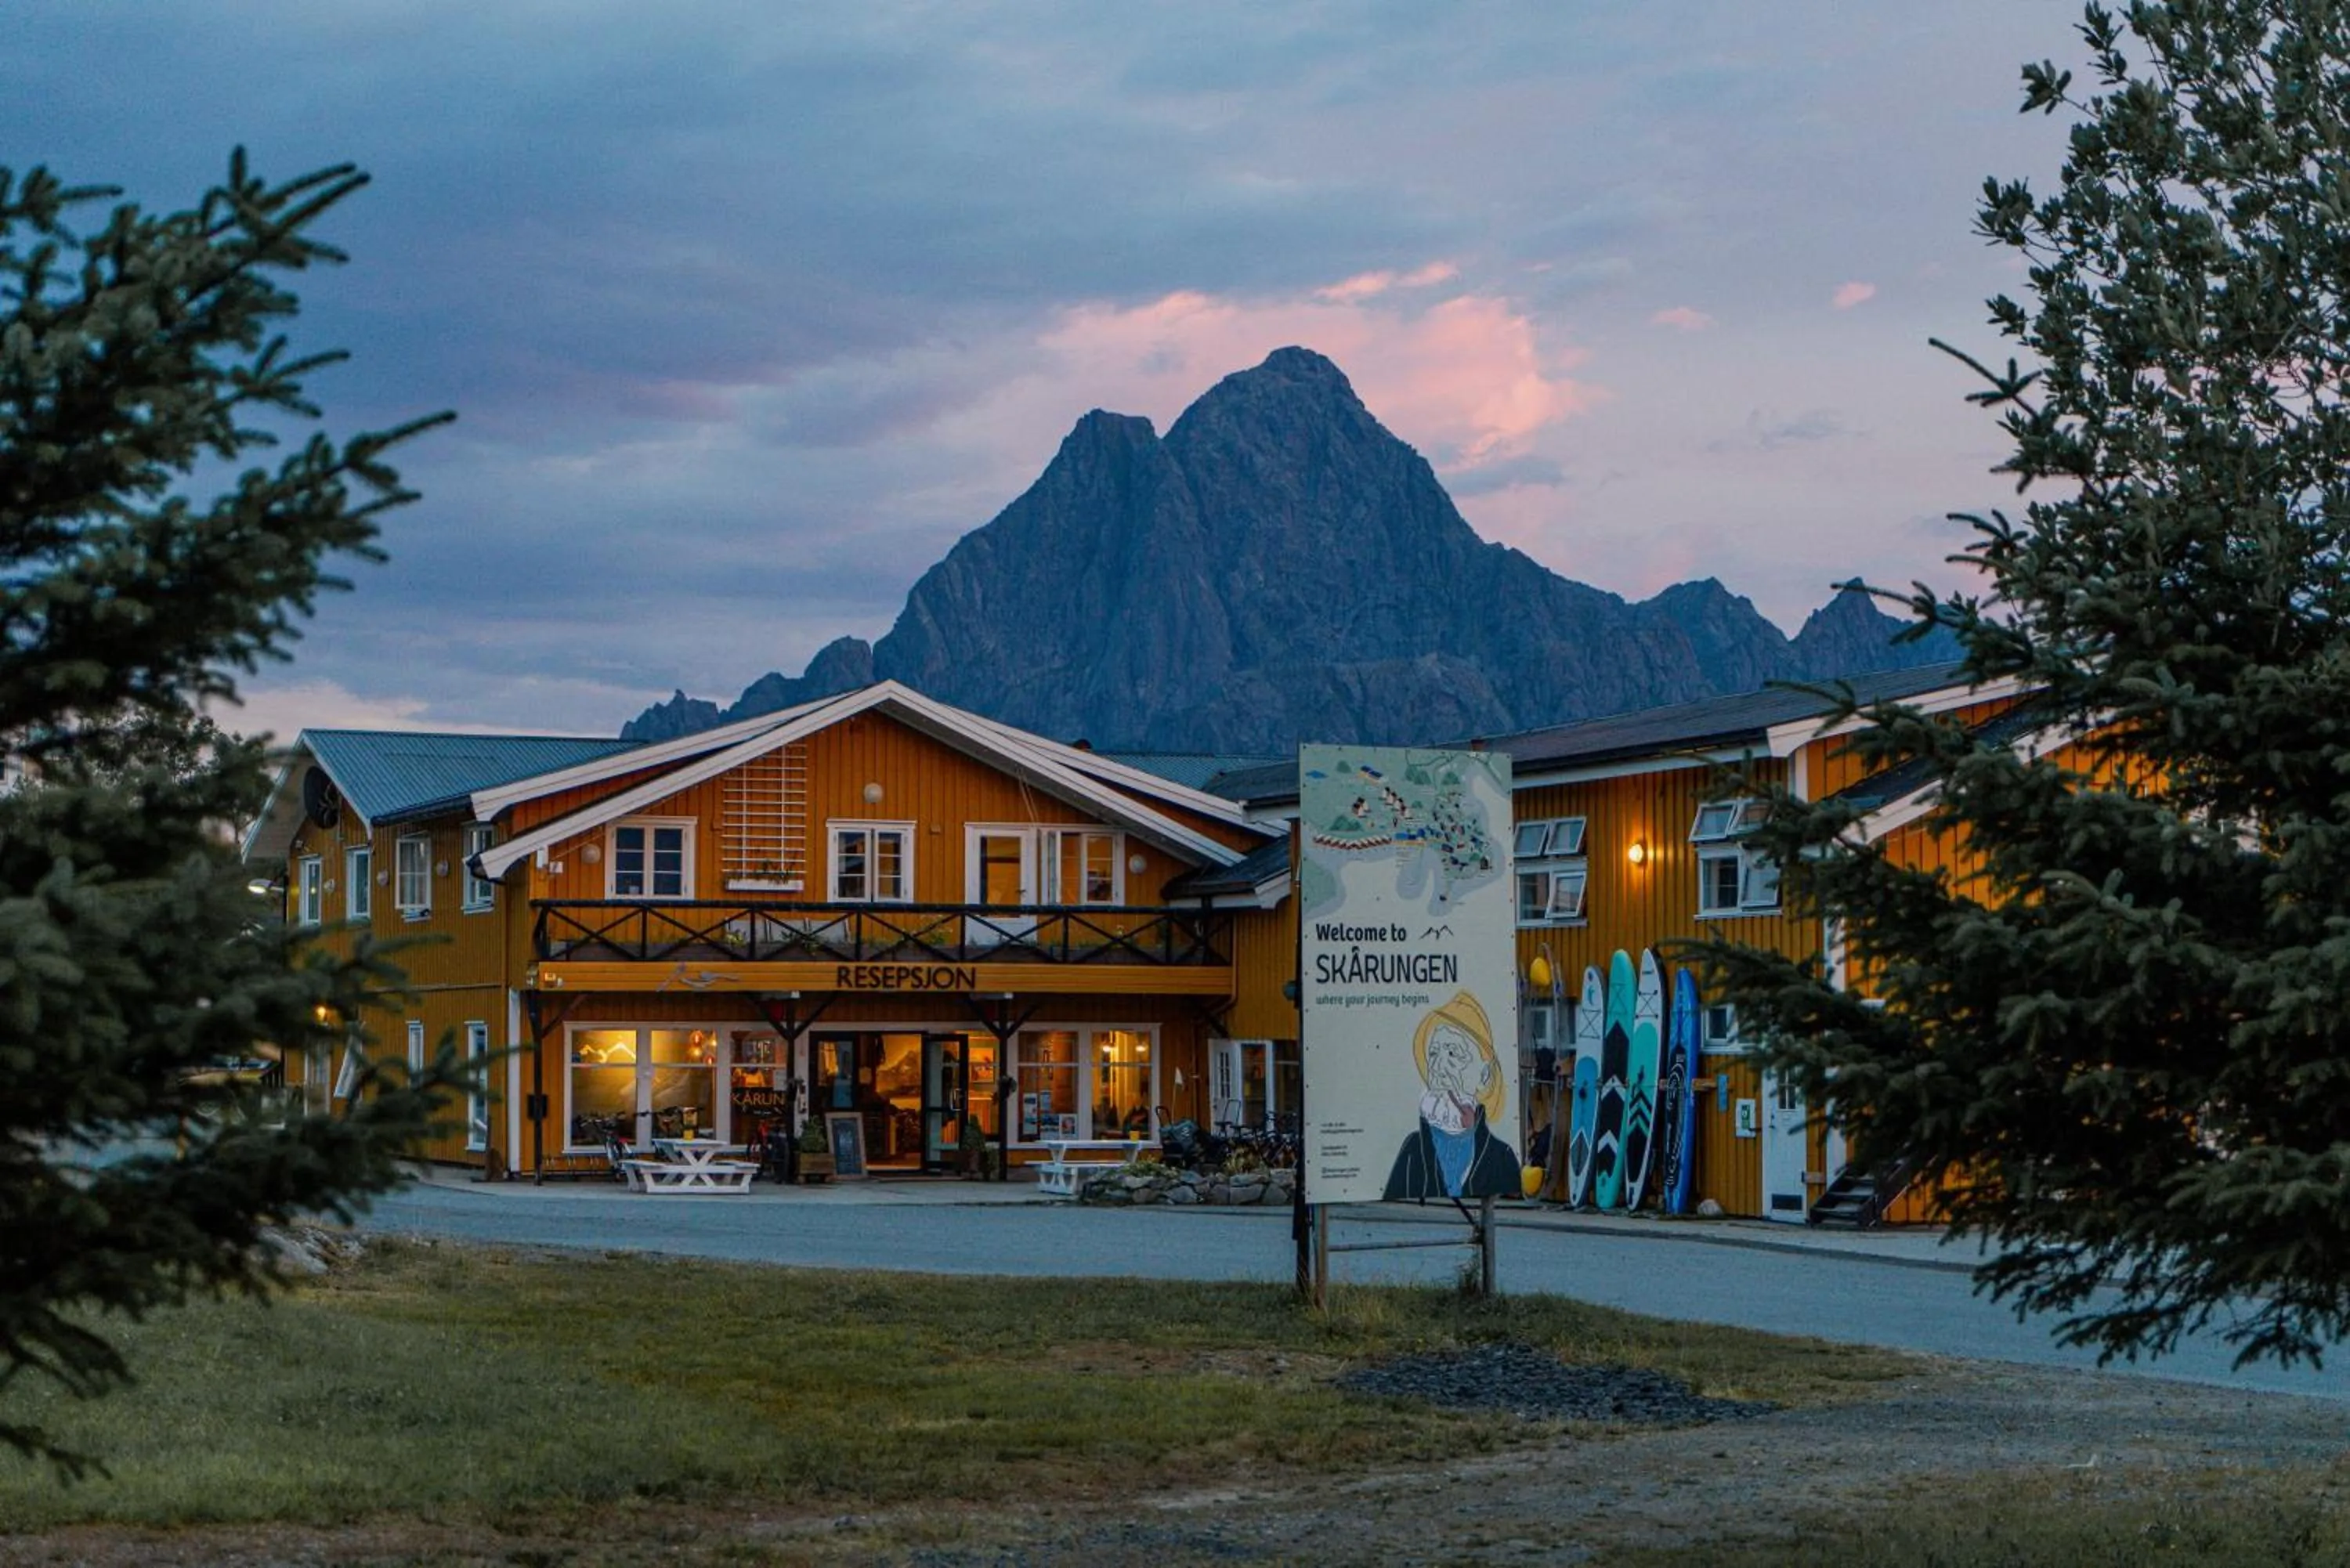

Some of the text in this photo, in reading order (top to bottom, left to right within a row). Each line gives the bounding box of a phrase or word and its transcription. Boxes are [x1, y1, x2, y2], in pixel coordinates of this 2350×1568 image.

[1316, 923, 1407, 941] Welcome to
[837, 966, 976, 989] RESEPSJON
[1316, 994, 1430, 1008] where your journey begins
